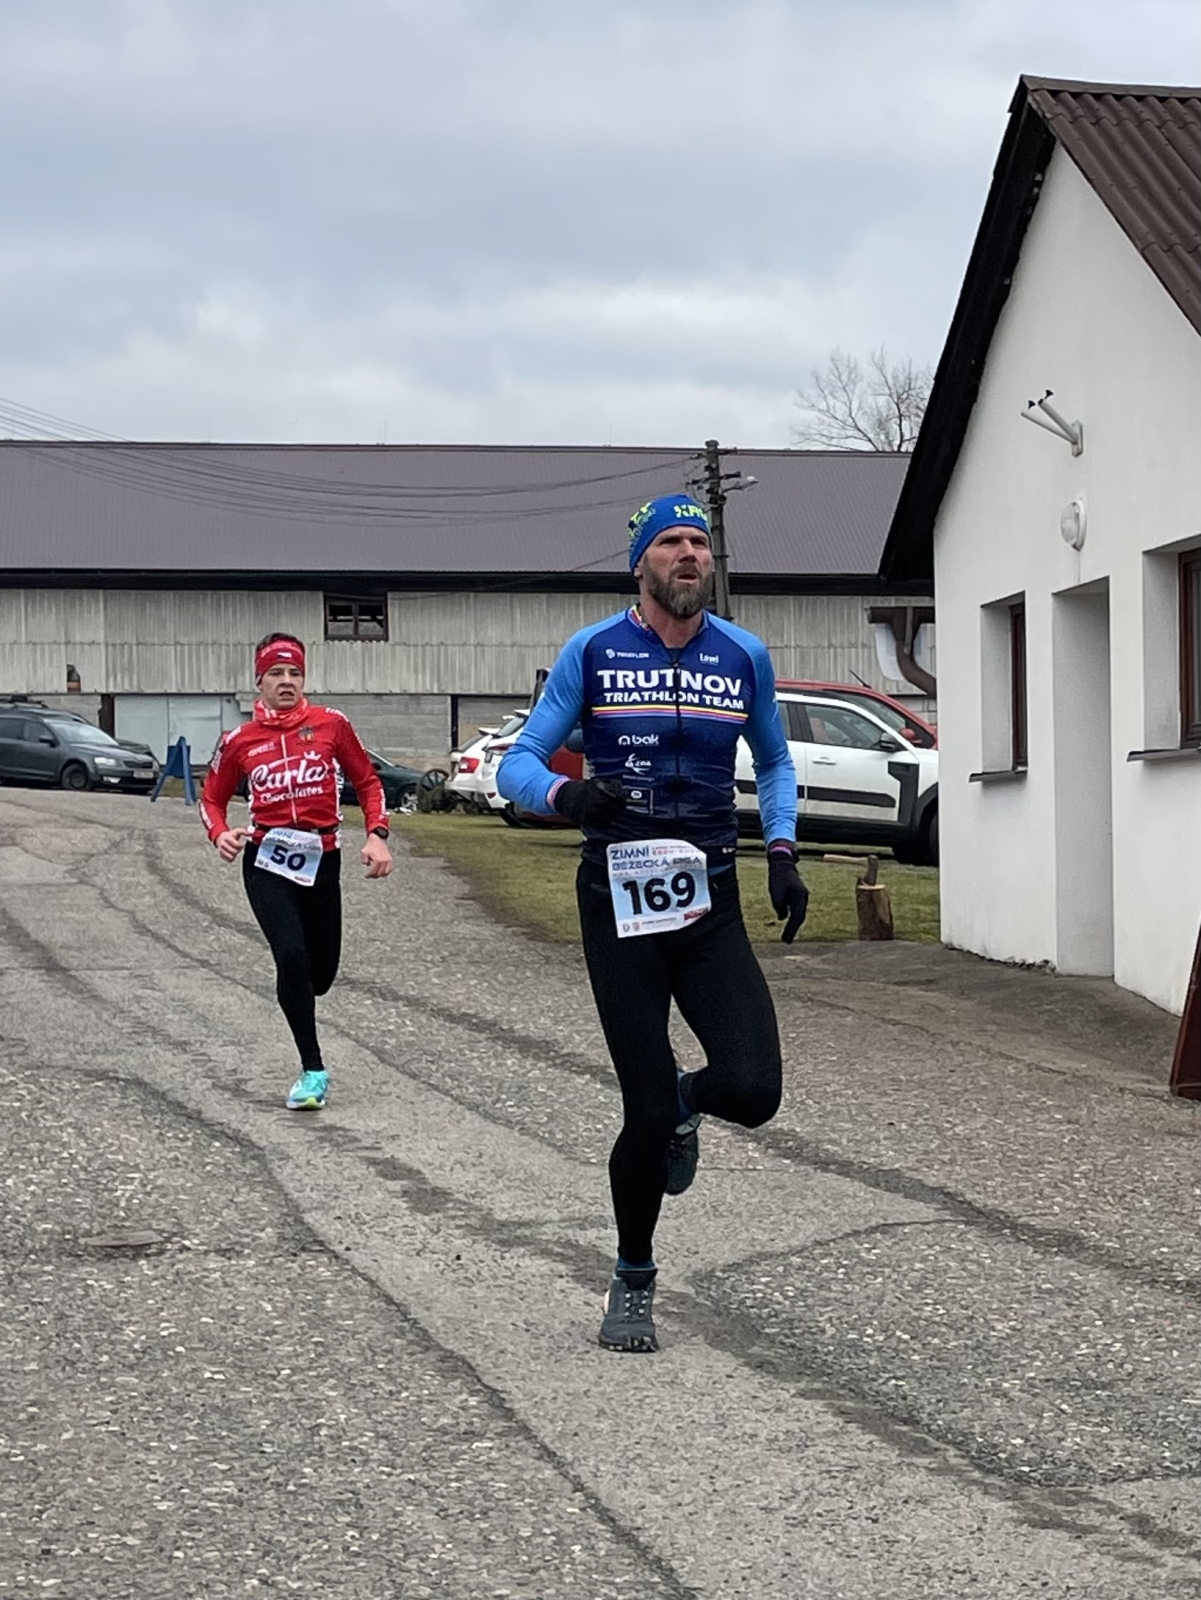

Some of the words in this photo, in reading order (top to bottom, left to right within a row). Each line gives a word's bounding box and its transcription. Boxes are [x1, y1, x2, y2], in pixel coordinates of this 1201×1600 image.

[597, 668, 742, 696] TRUTNOV
[604, 691, 699, 704] TRIATHLON
[702, 694, 744, 710] TEAM
[632, 733, 659, 745] bak
[251, 759, 326, 792] Carla
[270, 845, 306, 871] 50
[610, 846, 649, 860] ZIMNÍ
[622, 871, 696, 915] 169
